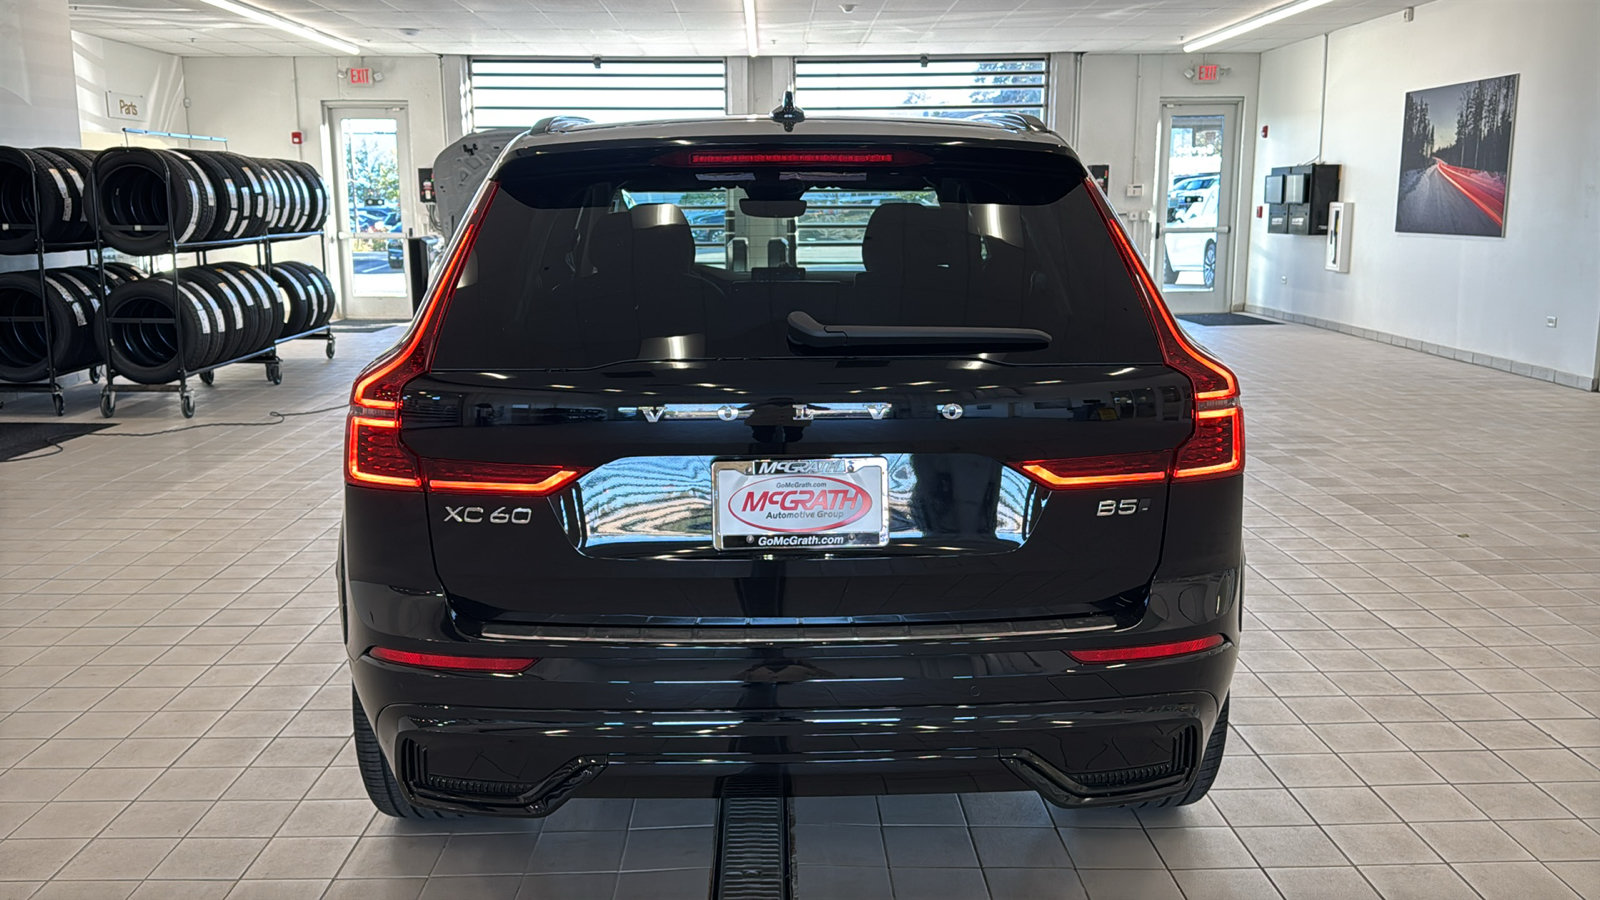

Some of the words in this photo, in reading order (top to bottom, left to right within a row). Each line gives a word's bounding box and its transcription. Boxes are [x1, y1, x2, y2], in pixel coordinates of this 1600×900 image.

[351, 68, 369, 84] EXIT
[1199, 65, 1217, 80] EXIT
[119, 99, 138, 116] Parts
[638, 403, 963, 423] VOLVO
[765, 511, 815, 520] Automotive
[816, 510, 844, 519] Group
[757, 536, 844, 547] GoMcGrath.com
